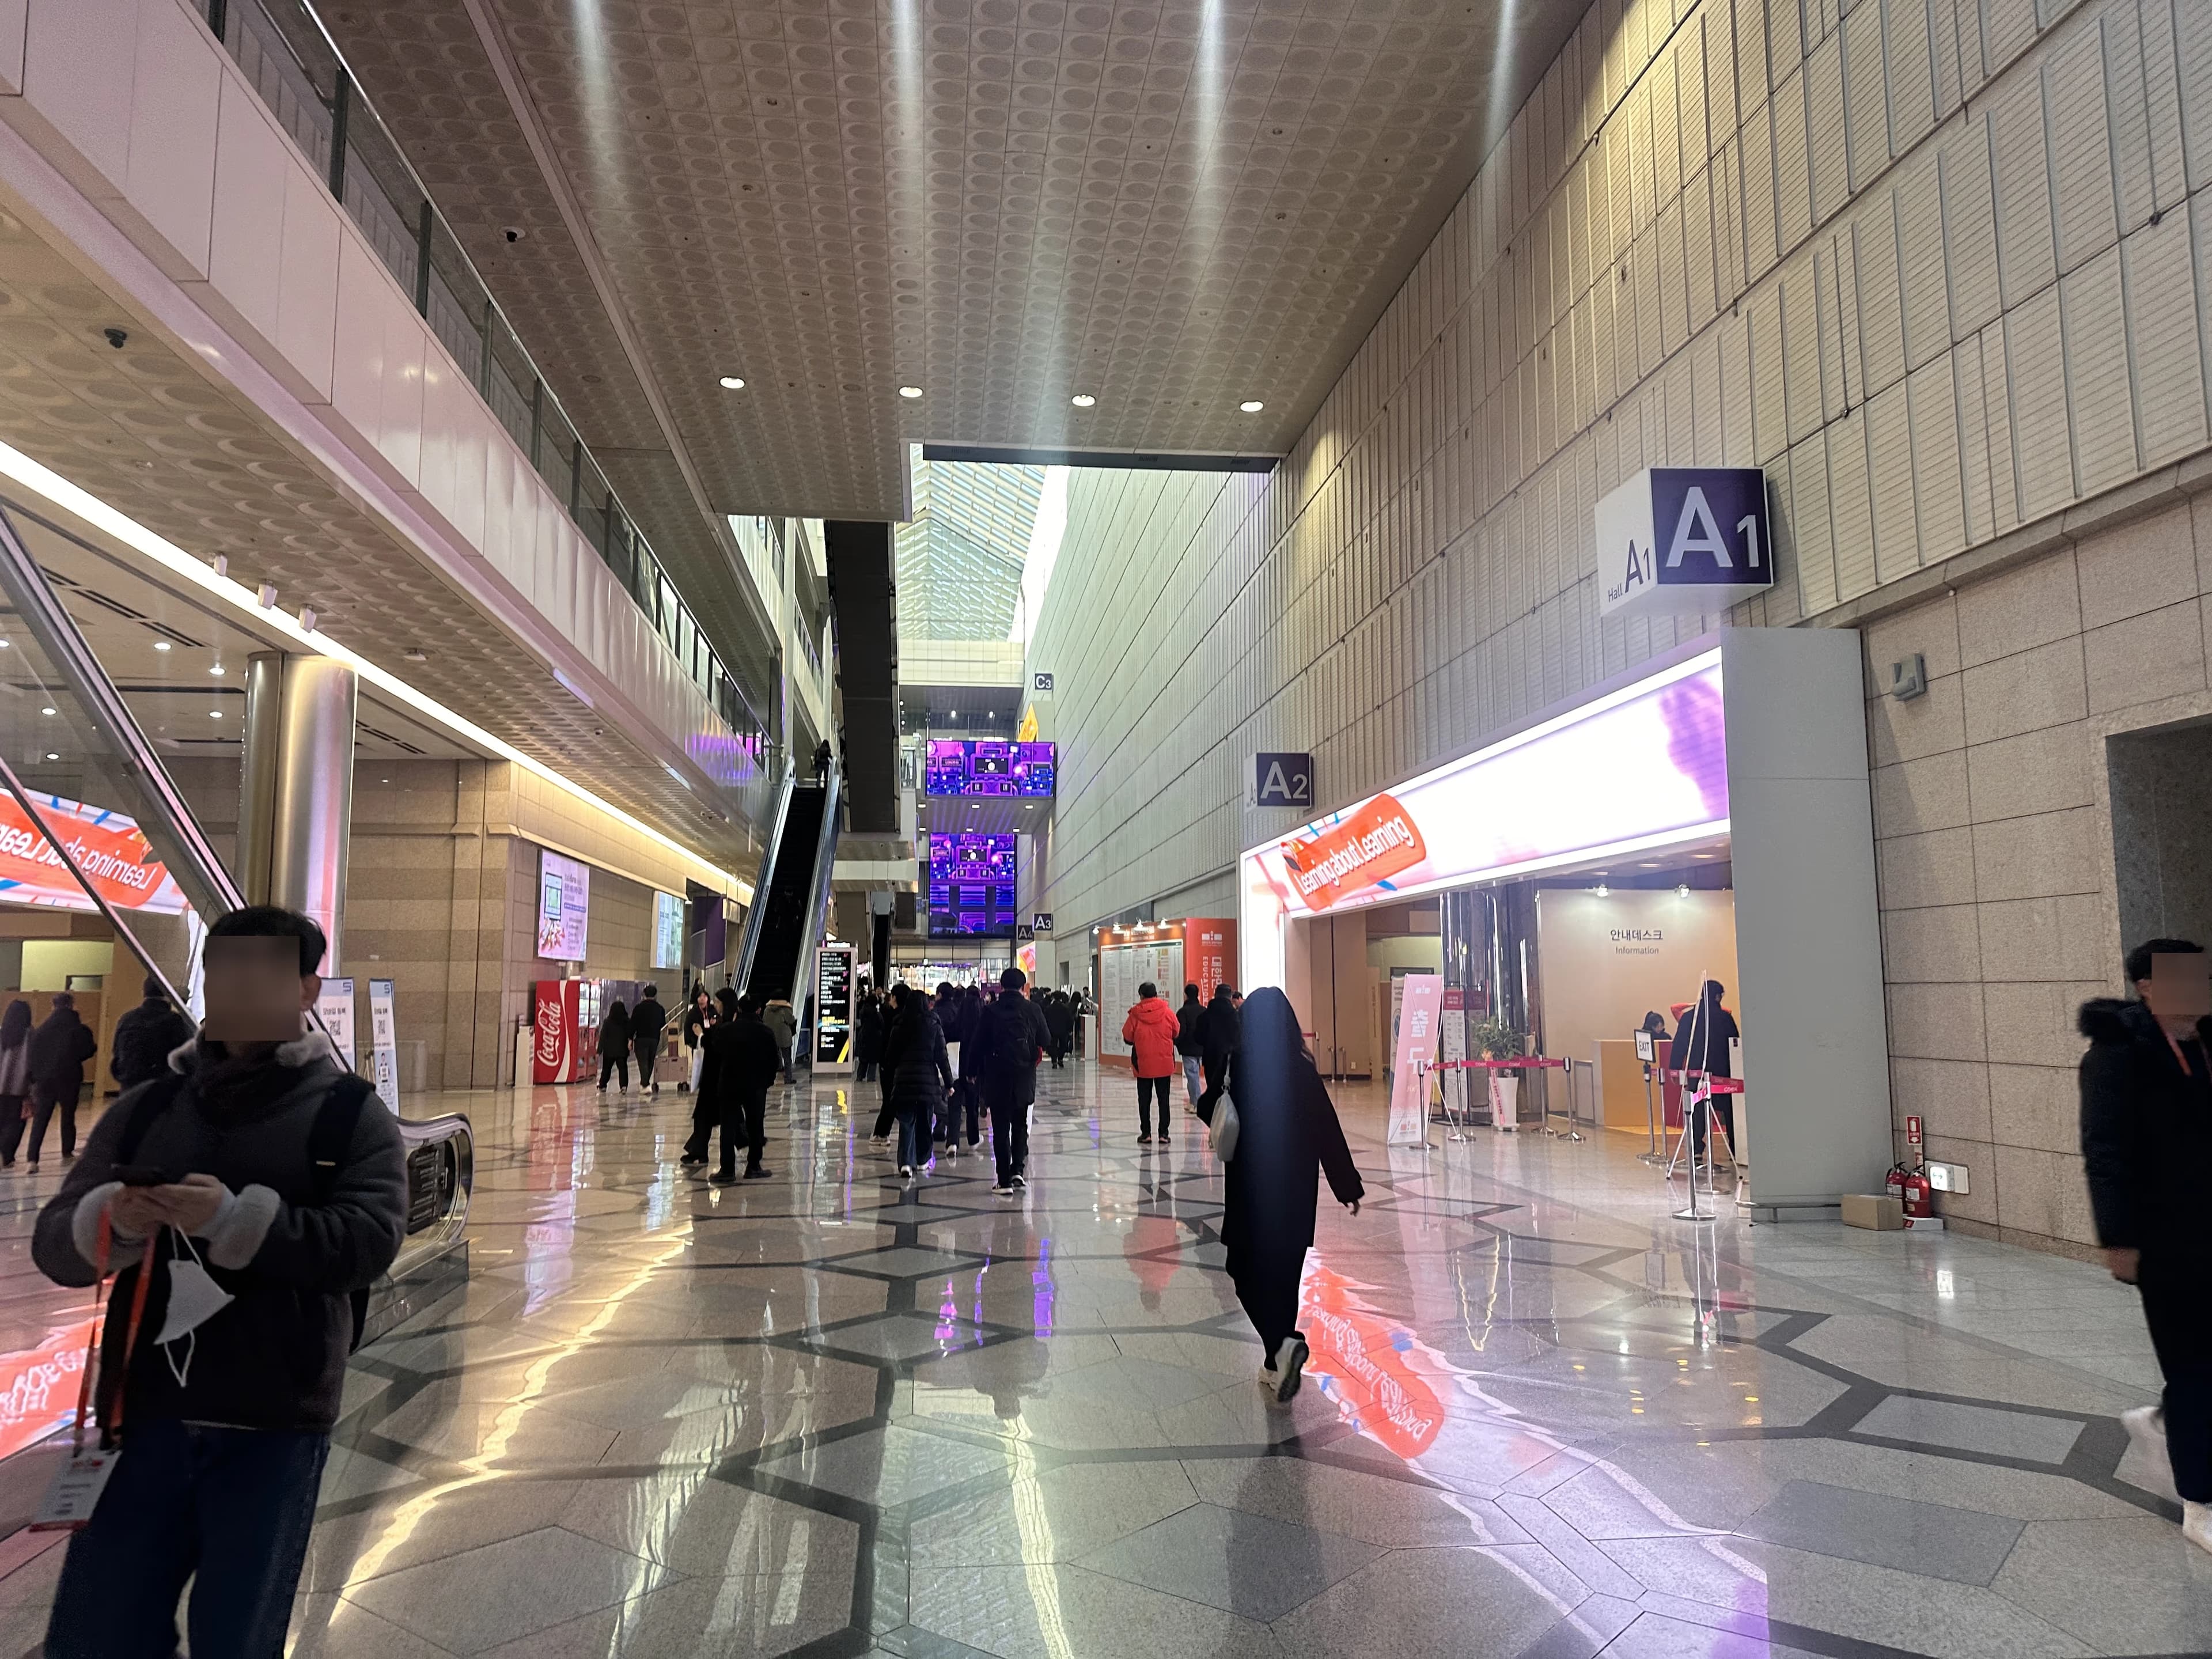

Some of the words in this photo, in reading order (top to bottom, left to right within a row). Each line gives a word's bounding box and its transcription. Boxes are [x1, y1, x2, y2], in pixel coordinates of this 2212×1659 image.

[1665, 486, 1759, 567] A1
[1608, 583, 1623, 603] Hall
[1624, 539, 1650, 593] A1
[1036, 675, 1051, 689] C3
[1260, 761, 1308, 800] A2
[1293, 859, 1341, 896] Learning
[1329, 840, 1365, 876] about
[1351, 815, 1416, 862] Learning
[1035, 915, 1051, 929] A3
[1018, 927, 1032, 939] A4
[1610, 929, 1663, 941] 안내데스크
[1616, 946, 1659, 955] Information
[1639, 1040, 1650, 1052] EXIT
